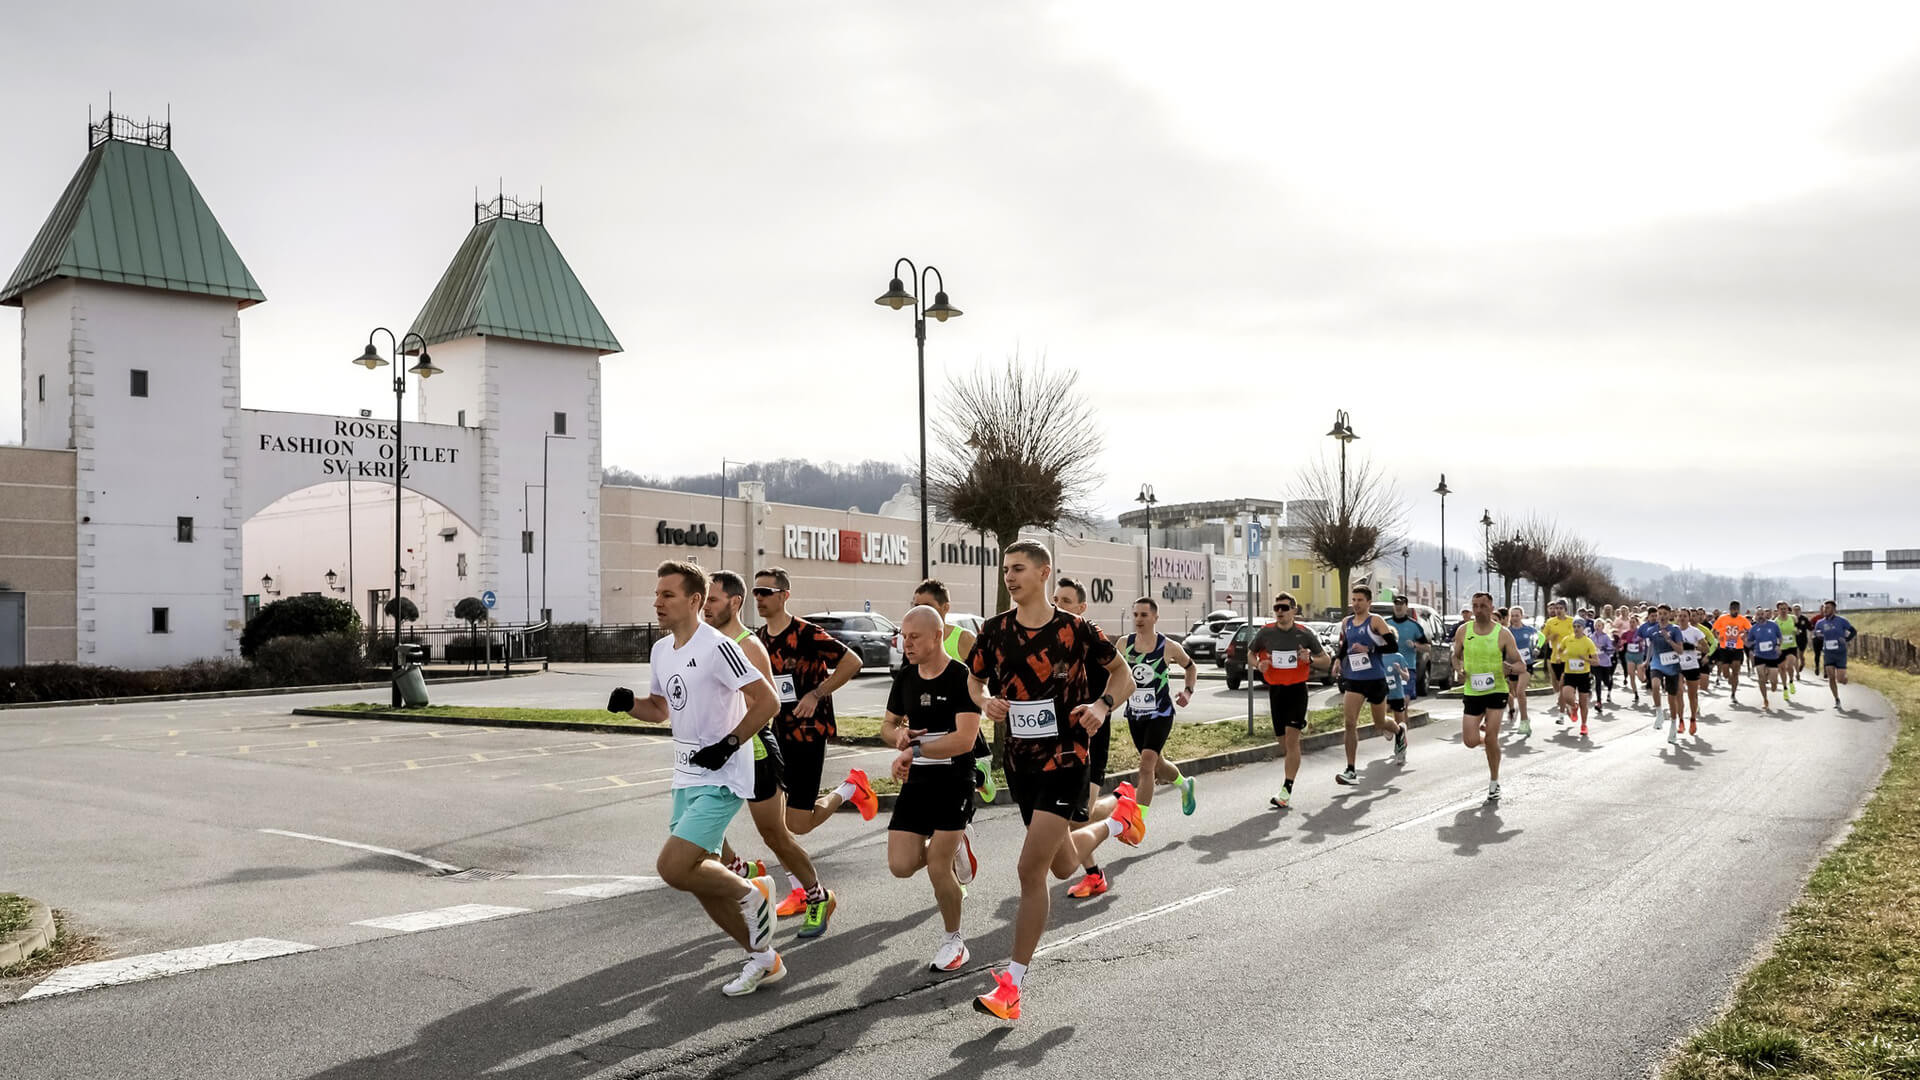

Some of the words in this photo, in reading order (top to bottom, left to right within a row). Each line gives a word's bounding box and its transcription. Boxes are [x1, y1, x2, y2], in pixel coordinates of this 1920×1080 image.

[335, 420, 398, 440] ROSES
[260, 434, 354, 456] FASHION
[784, 524, 840, 561] RETRO
[861, 531, 909, 565] JEANS
[1251, 528, 1258, 553] P
[1091, 577, 1113, 604] OVS
[1011, 713, 1037, 728] 136
